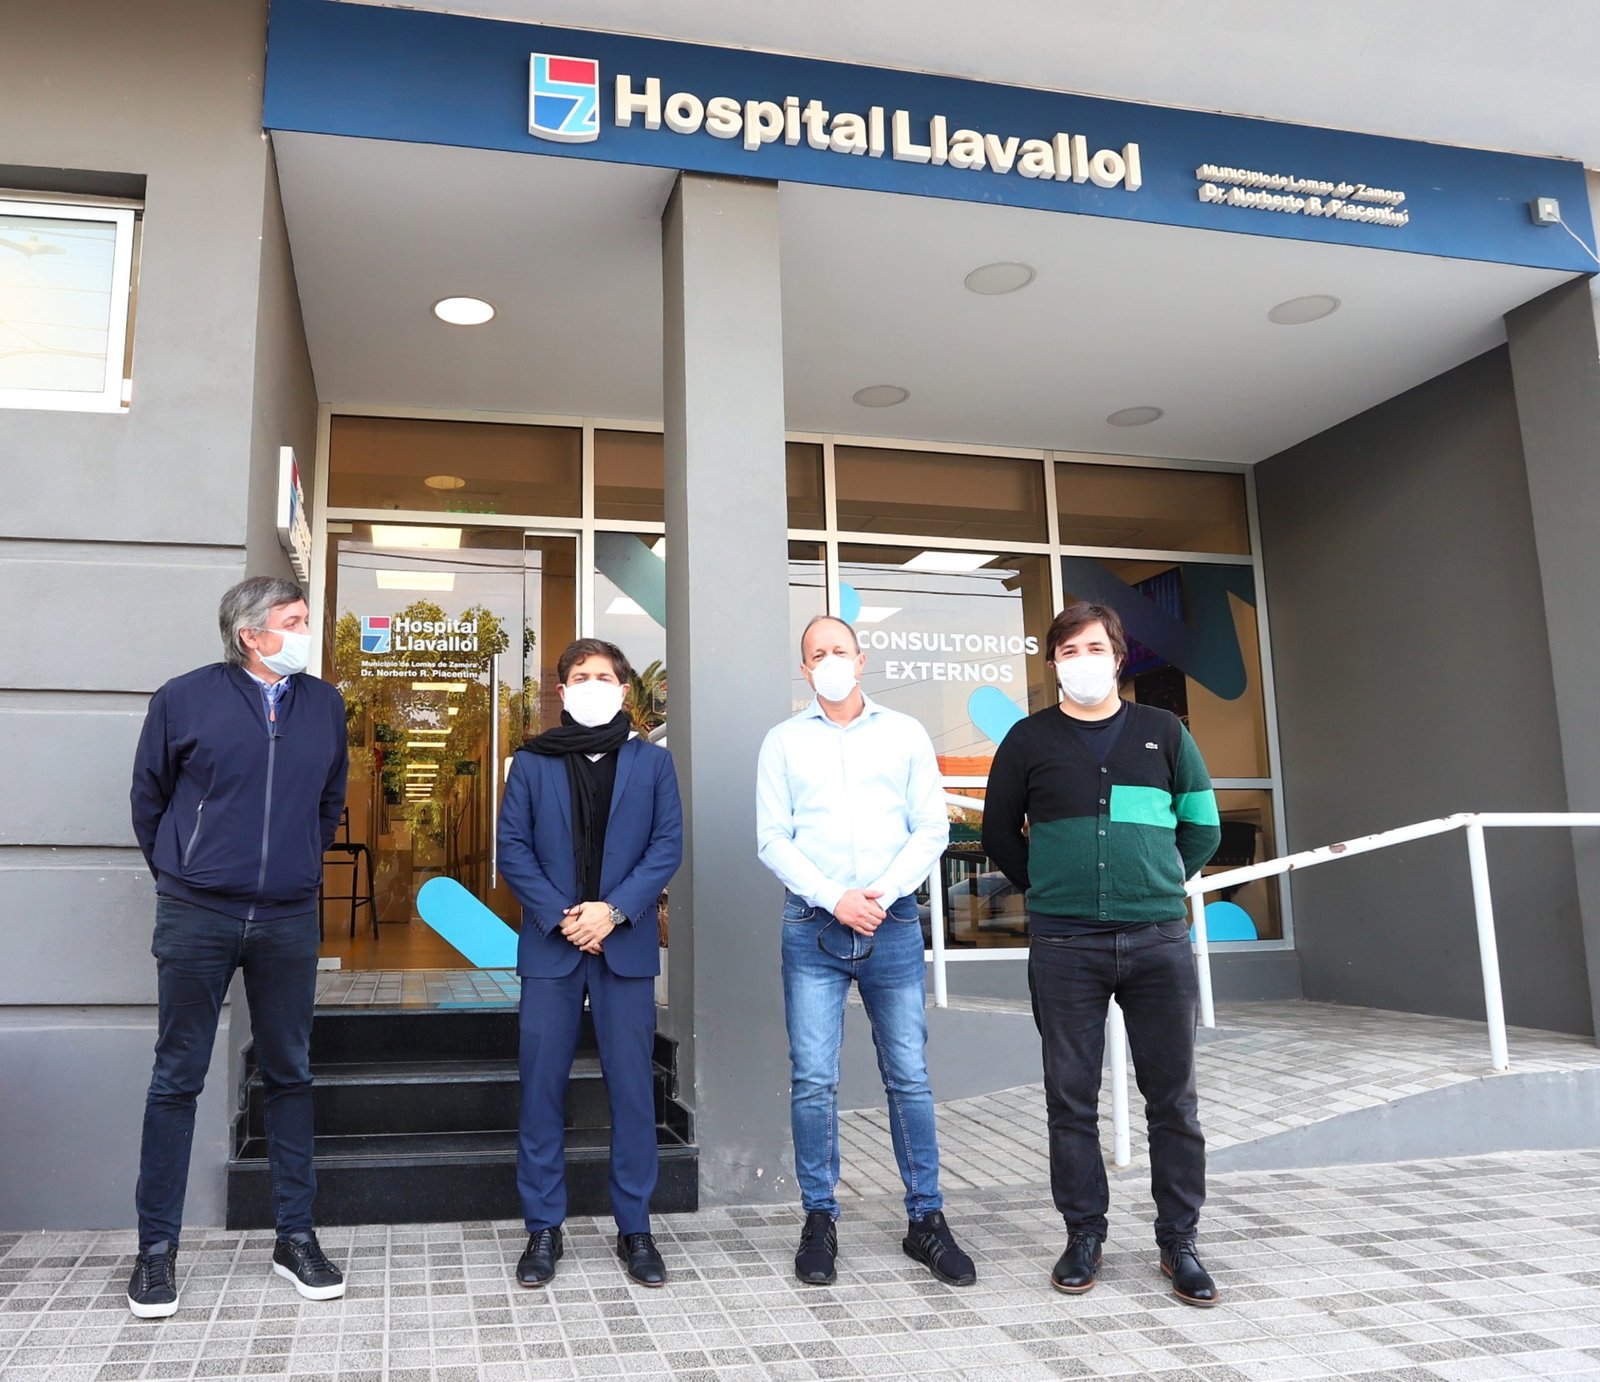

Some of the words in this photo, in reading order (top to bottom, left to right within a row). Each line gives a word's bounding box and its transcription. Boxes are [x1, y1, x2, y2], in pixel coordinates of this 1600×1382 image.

[616, 74, 884, 157] Hospital
[893, 110, 1142, 191] Llavallol
[1287, 175, 1334, 195] Lomas
[1332, 182, 1355, 198] de
[1353, 184, 1405, 205] Zamora
[1199, 183, 1227, 203] Dr.
[1229, 187, 1304, 213] Norberto
[1306, 197, 1326, 215] R.
[1328, 200, 1409, 226] Piacentini
[395, 617, 478, 637] Hospital
[395, 636, 478, 652] Llavallol
[857, 630, 1040, 655] CONSULTORIOS
[361, 660, 398, 668] Municipio
[361, 669, 374, 677] Dr.
[376, 669, 418, 677] Norberto
[420, 669, 429, 677] R.
[885, 660, 1013, 683] EXTERNOS
